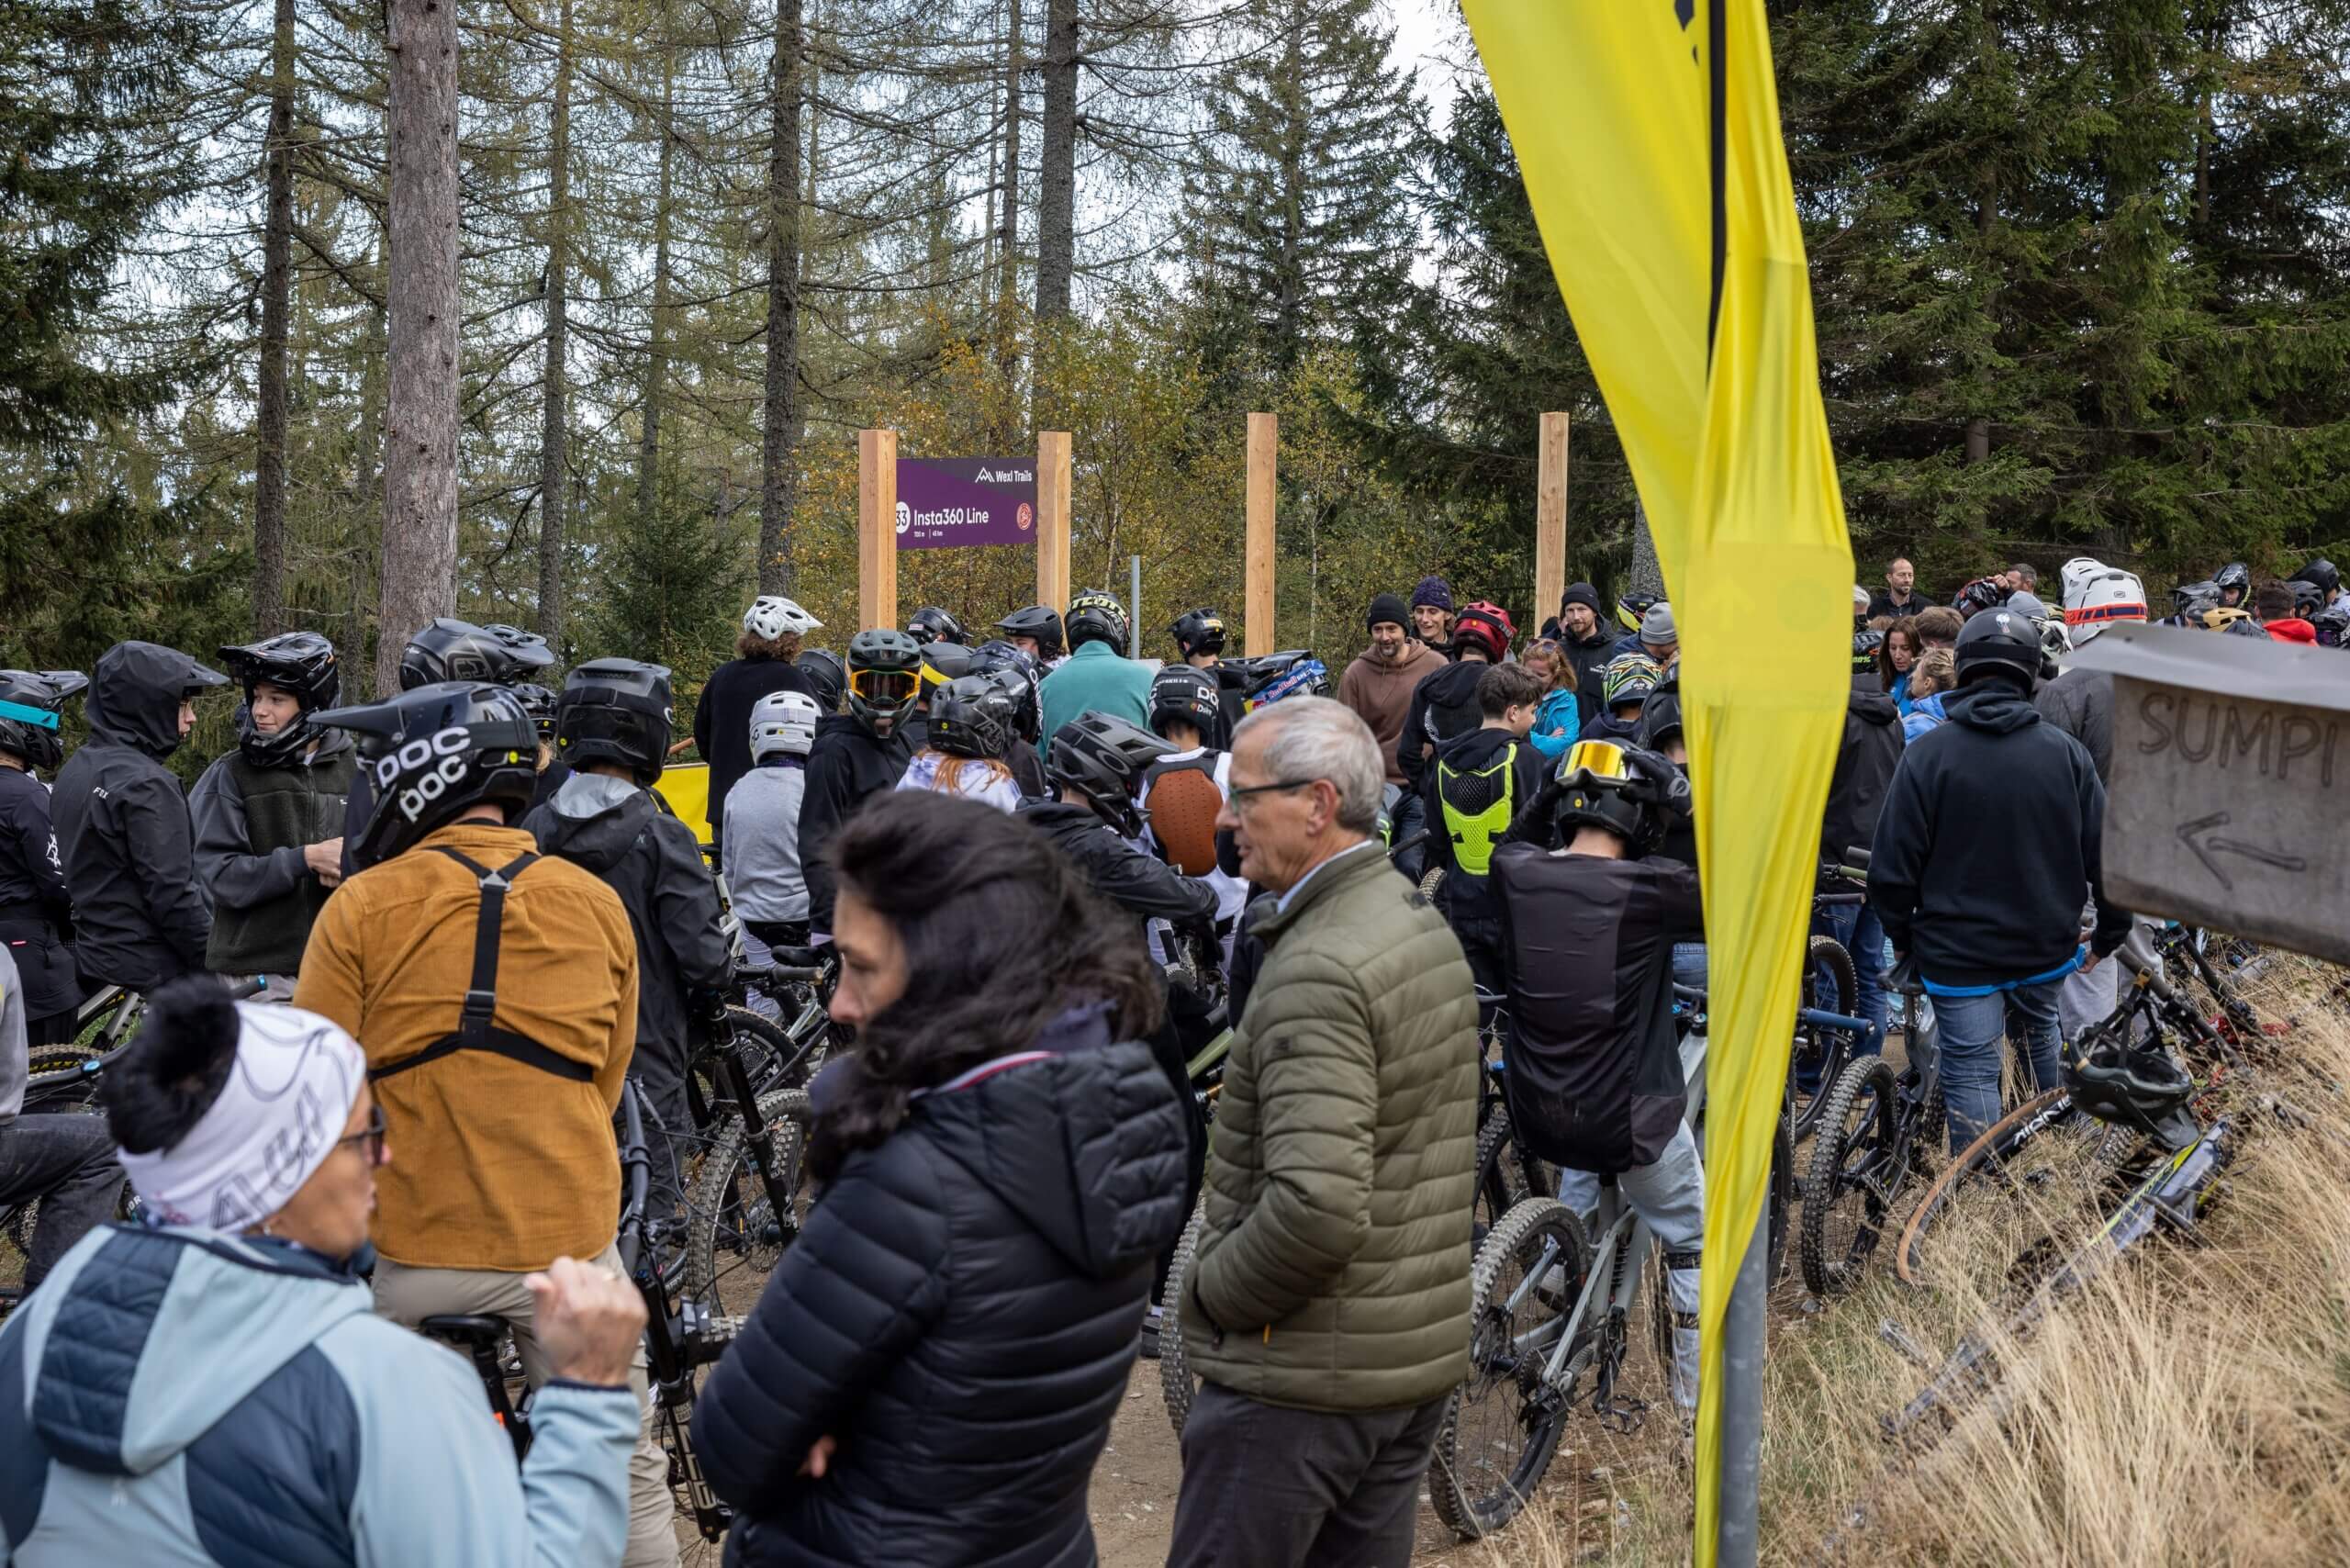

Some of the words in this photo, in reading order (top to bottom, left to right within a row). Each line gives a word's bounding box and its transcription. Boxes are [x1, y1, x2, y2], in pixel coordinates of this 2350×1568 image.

[995, 469, 1013, 483] Wexl
[1014, 469, 1033, 482] Trails
[913, 508, 964, 527] Insta360
[967, 507, 990, 524] Line
[376, 726, 471, 789] POC
[93, 786, 110, 800] FOX
[398, 755, 468, 824] POC
